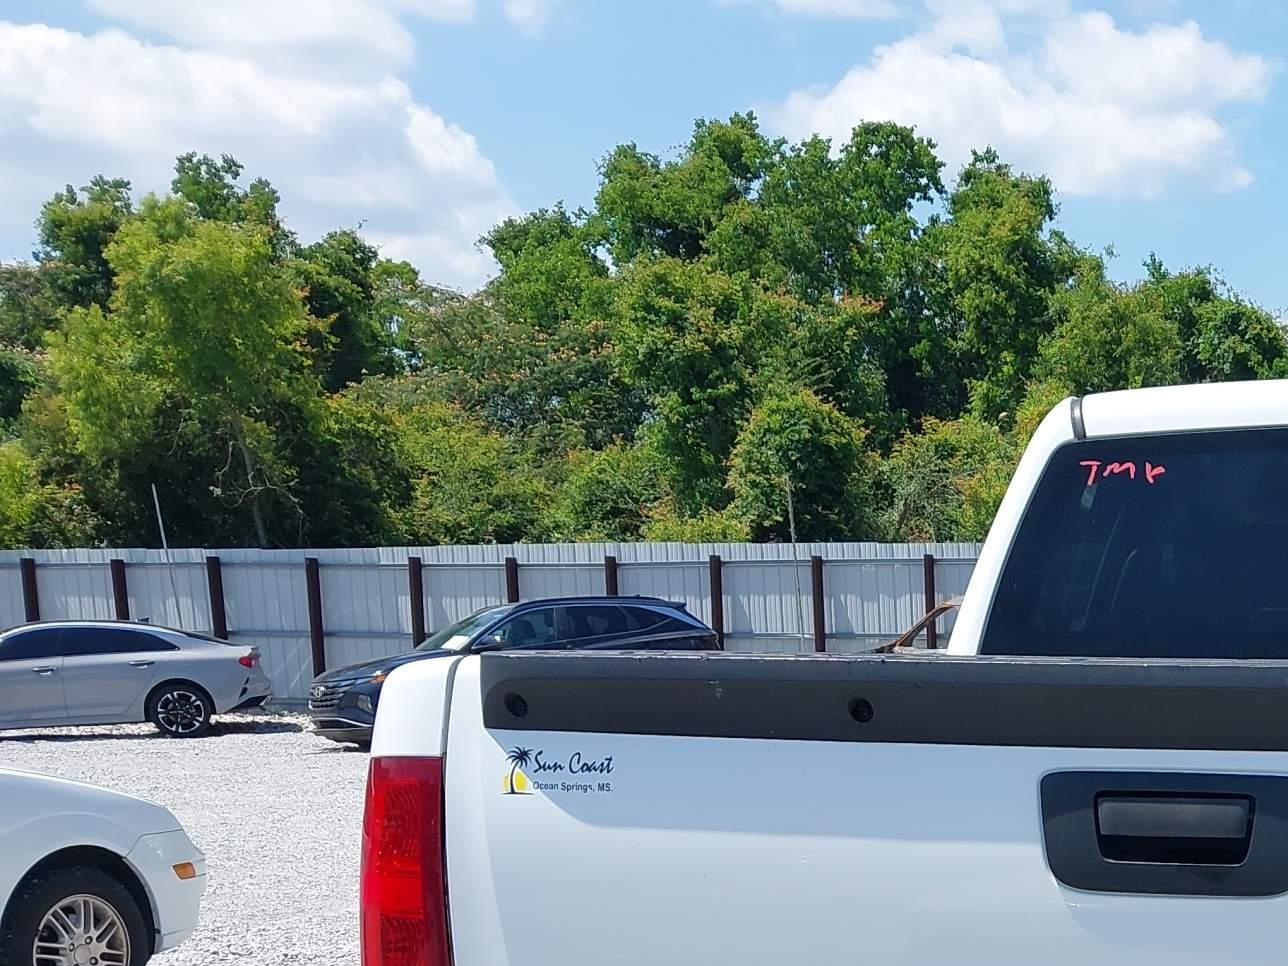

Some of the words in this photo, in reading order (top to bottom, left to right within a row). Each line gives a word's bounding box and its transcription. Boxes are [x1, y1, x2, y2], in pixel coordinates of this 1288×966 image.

[533, 749, 565, 773] Sun
[568, 751, 614, 774] Coast
[533, 781, 559, 791] Ocean
